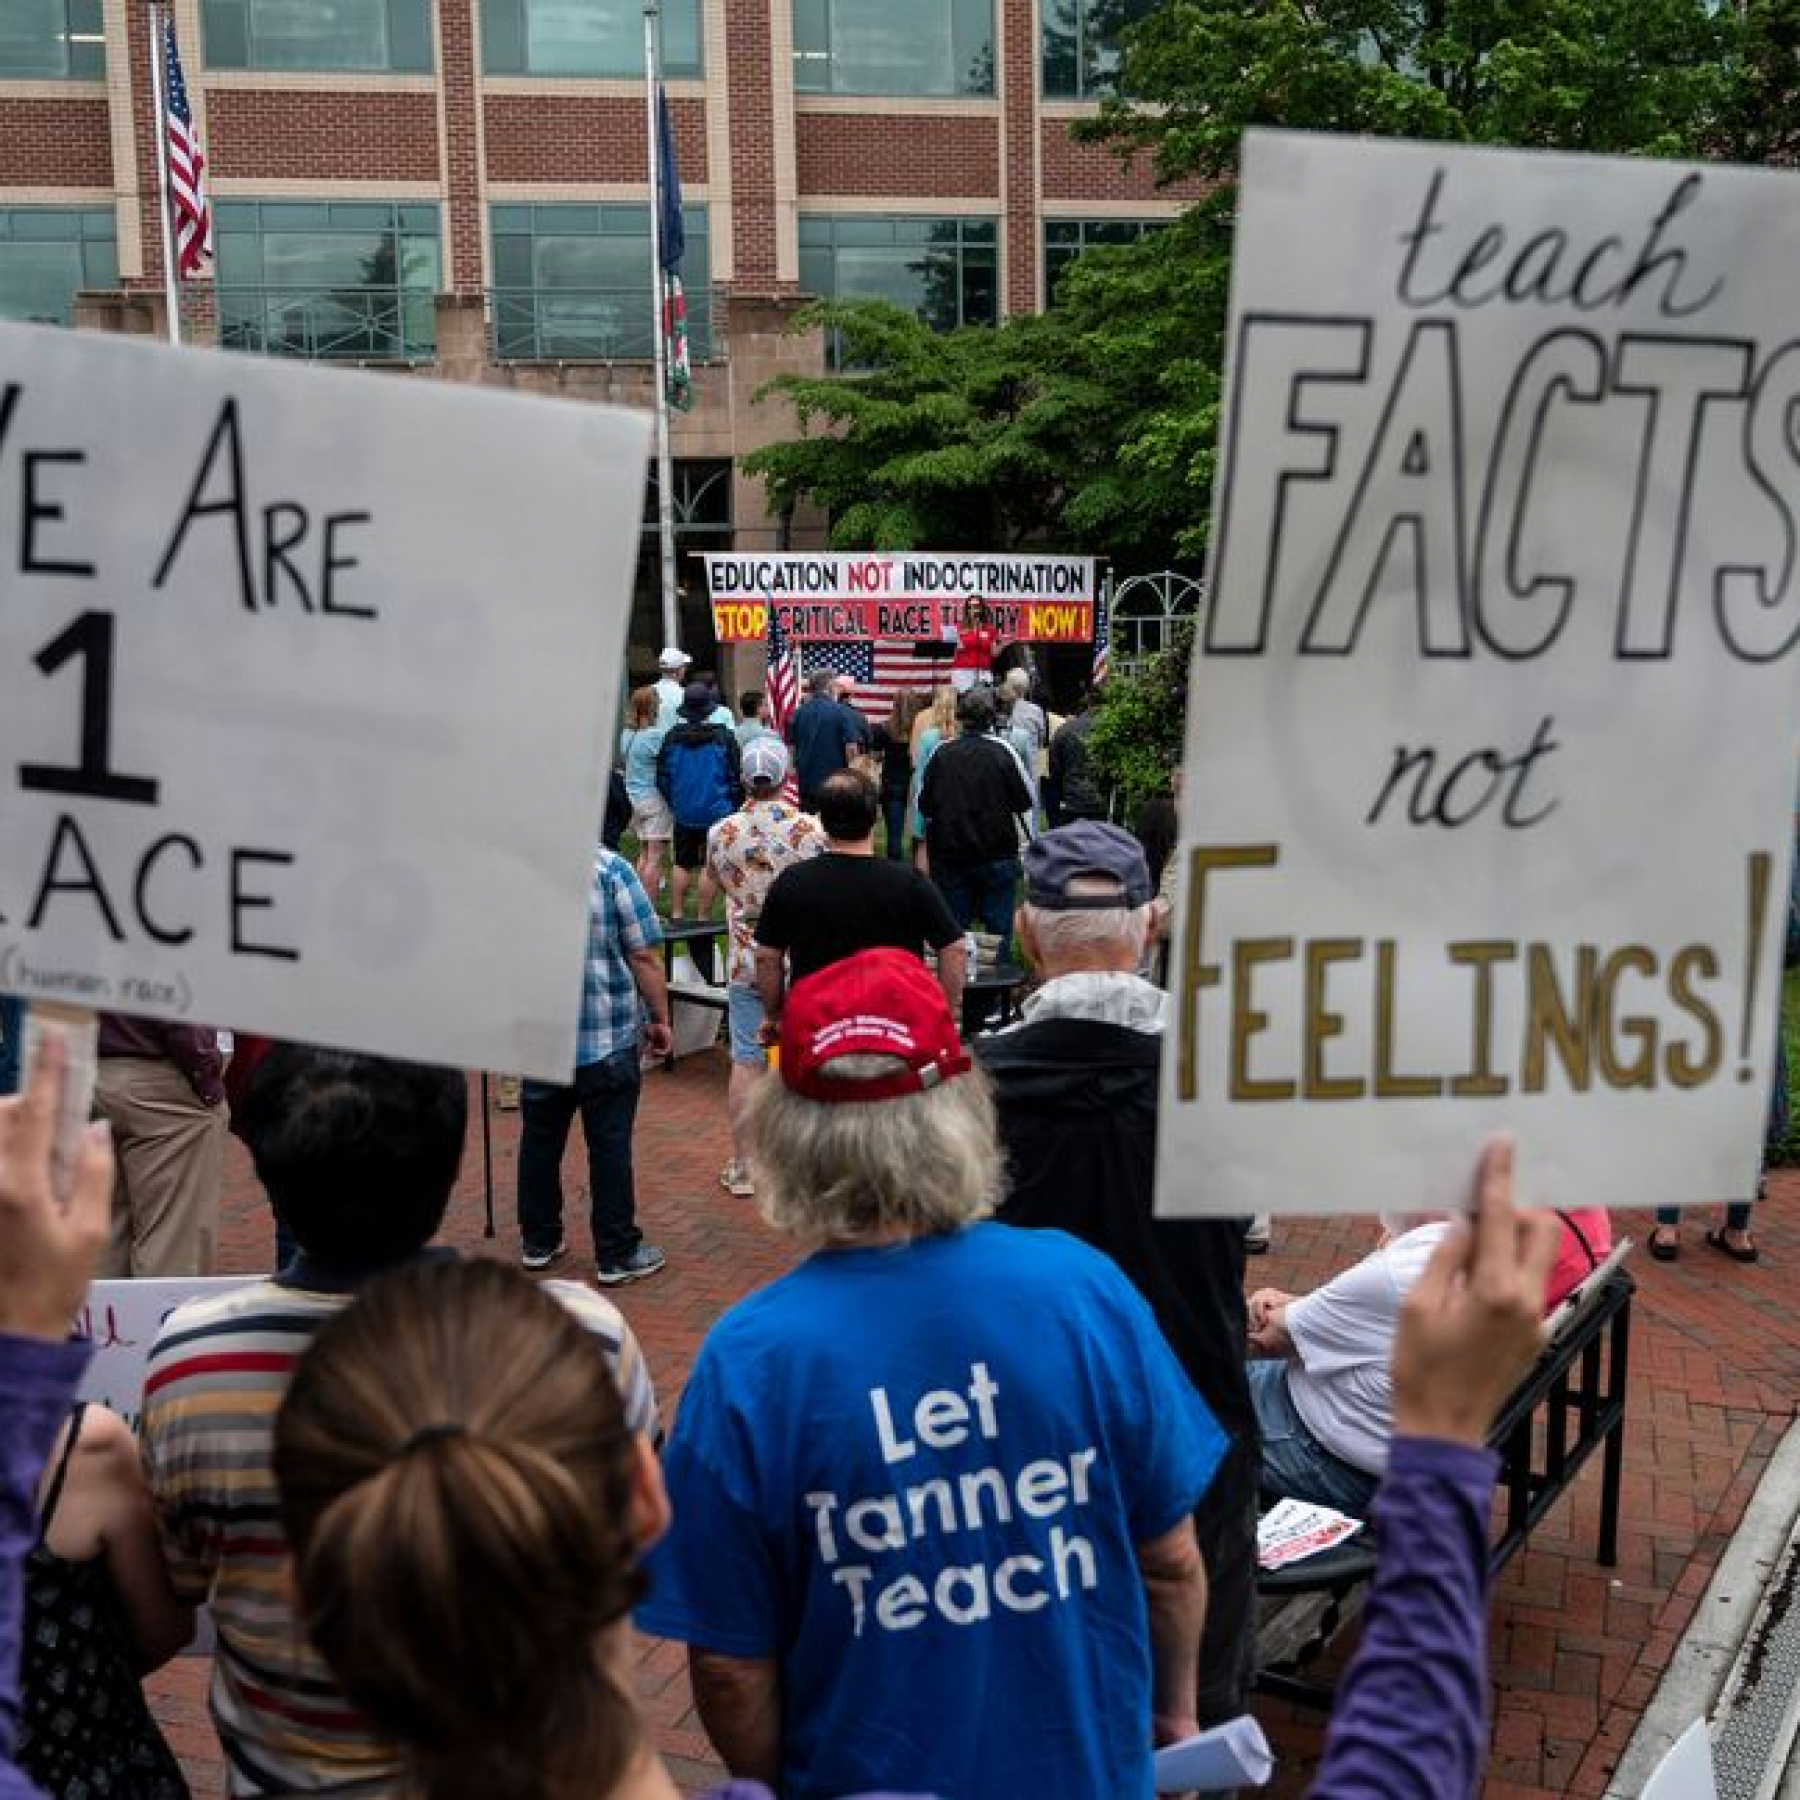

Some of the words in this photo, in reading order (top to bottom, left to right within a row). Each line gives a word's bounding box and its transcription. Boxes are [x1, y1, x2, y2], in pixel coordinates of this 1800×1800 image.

[1397, 166, 1724, 317] teach
[0, 379, 98, 580] E
[151, 394, 378, 619] ARE
[1203, 310, 1800, 664] FACTS
[711, 561, 838, 591] EDUCATION
[848, 562, 893, 591] NOT
[903, 563, 1085, 593] INDOCTRINATION
[715, 605, 766, 637] STOP
[779, 606, 868, 635] CRITICAL
[878, 606, 931, 635] RACE
[16, 610, 160, 806] 1
[1366, 715, 1560, 829] not
[0, 812, 300, 962] ACE
[1177, 843, 1773, 1102] FEELINGS!
[870, 1362, 999, 1464] Let
[804, 1447, 1097, 1564] Tanner
[832, 1527, 1098, 1638] Teach
